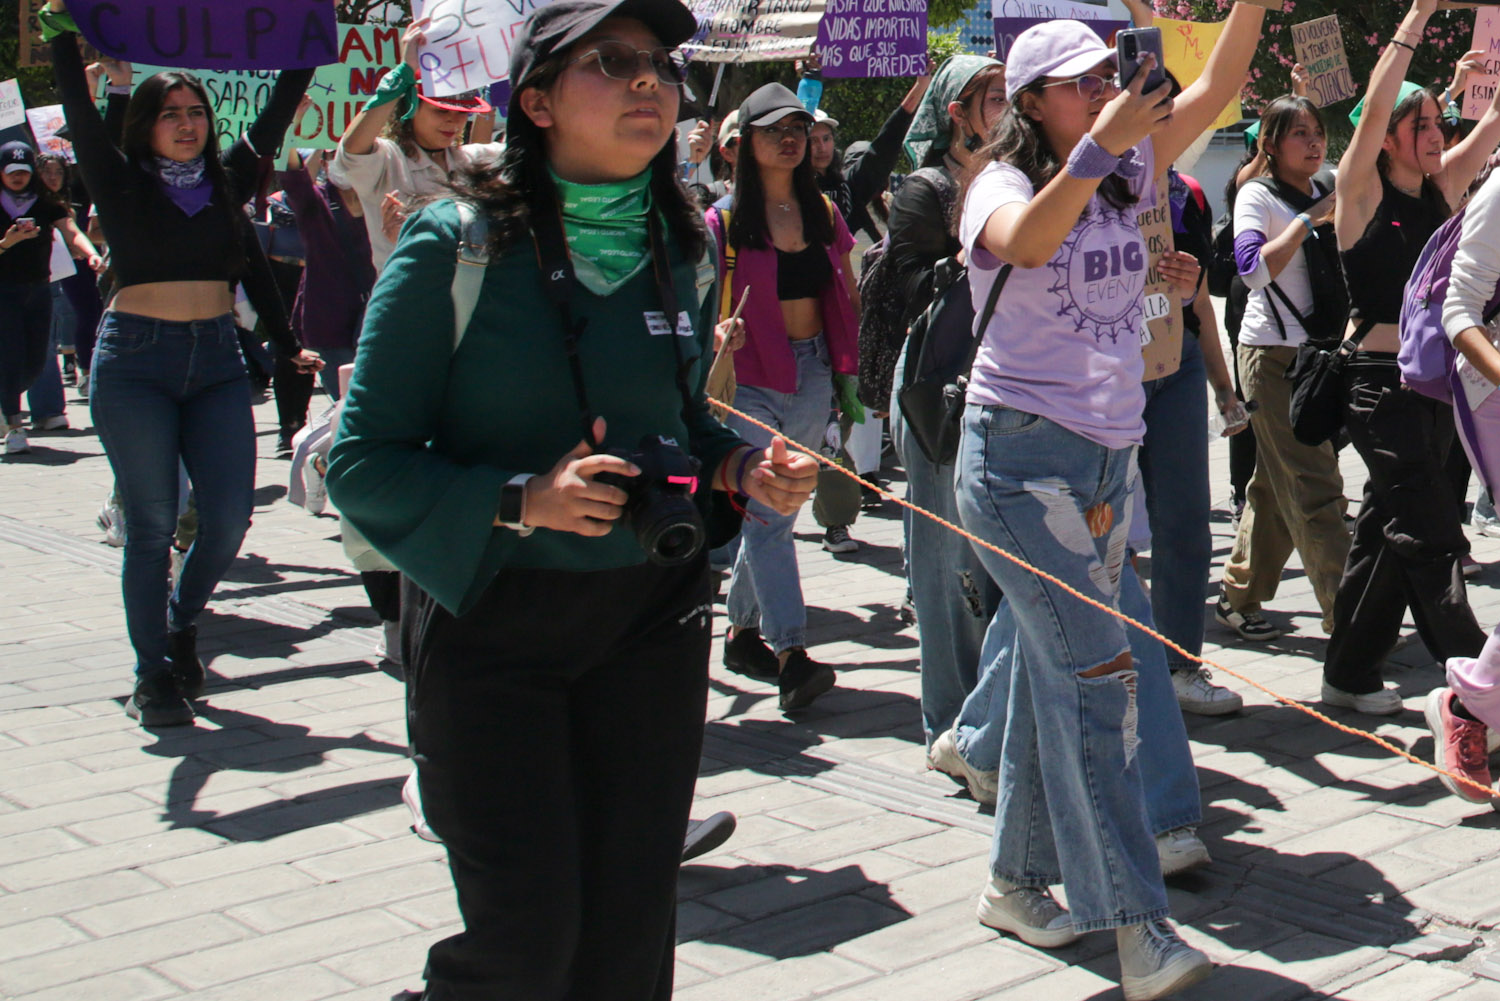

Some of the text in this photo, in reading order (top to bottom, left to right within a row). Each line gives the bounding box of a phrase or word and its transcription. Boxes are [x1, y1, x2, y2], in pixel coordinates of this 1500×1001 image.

[90, 2, 336, 61] CULPA
[719, 18, 782, 35] HOMBRE
[825, 16, 921, 42] VIDAS IMPORTEN
[849, 42, 874, 63] QUE
[876, 41, 898, 57] SUS
[867, 52, 928, 78] PAREDES
[1083, 241, 1143, 283] BIG
[1086, 272, 1140, 304] EVENT
